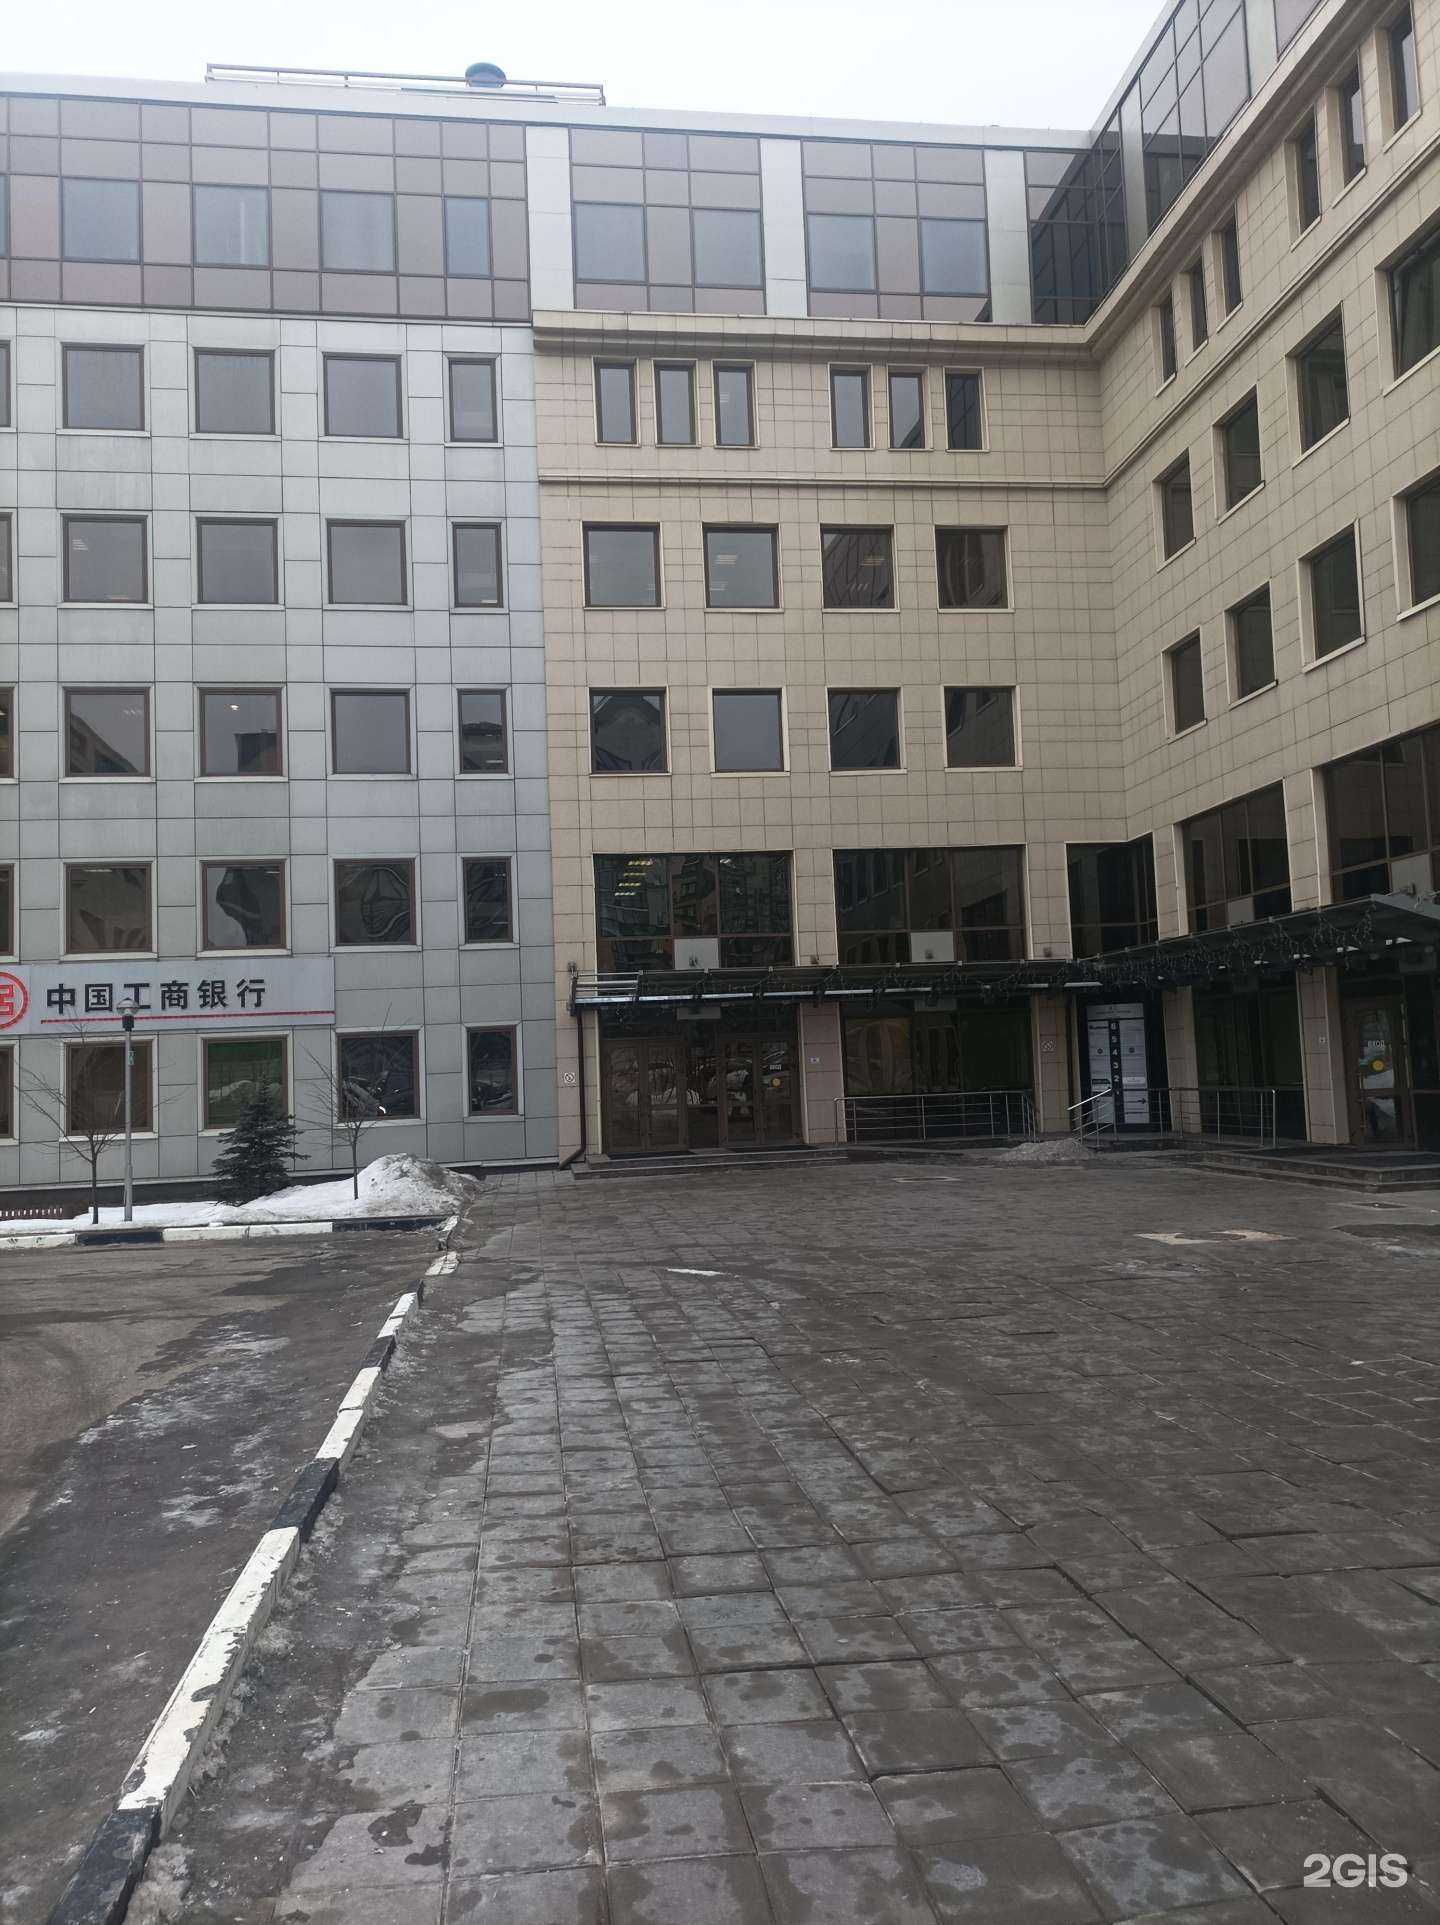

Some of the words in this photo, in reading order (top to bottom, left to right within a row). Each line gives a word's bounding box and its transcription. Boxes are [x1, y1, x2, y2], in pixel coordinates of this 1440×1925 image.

[46, 978, 266, 1015] 中国工商银行
